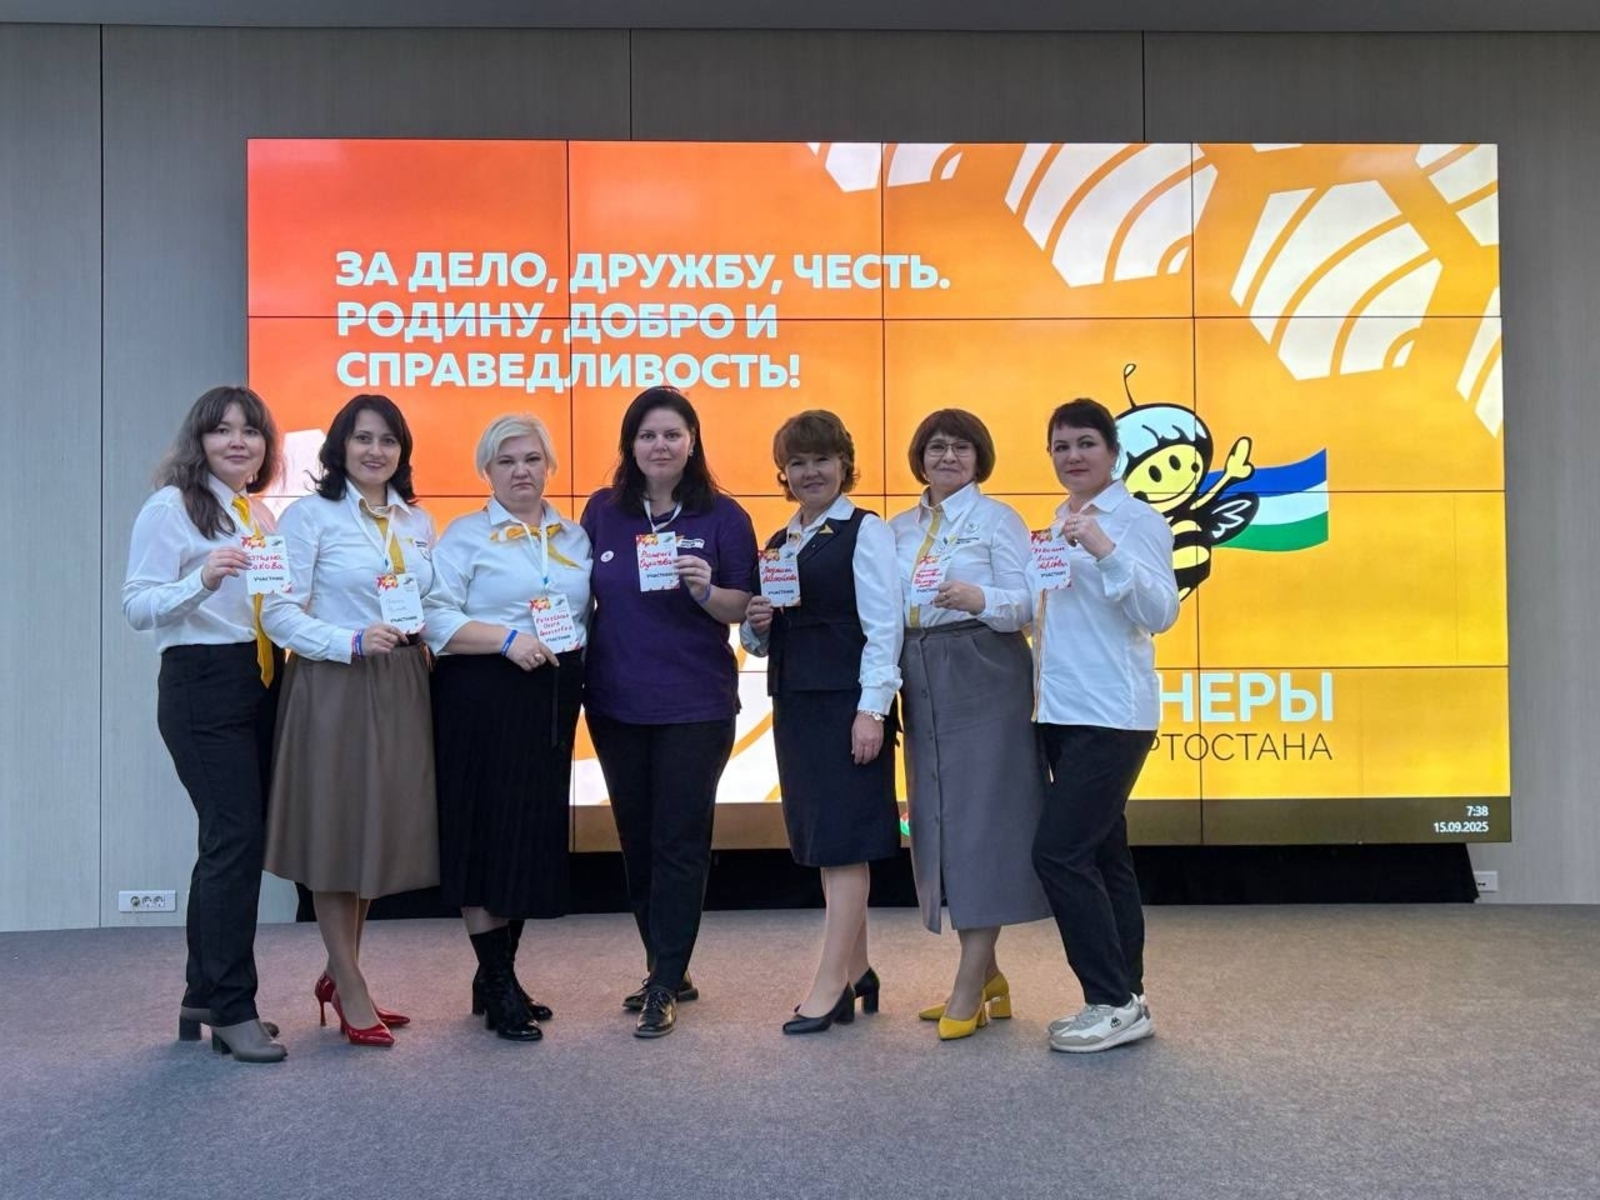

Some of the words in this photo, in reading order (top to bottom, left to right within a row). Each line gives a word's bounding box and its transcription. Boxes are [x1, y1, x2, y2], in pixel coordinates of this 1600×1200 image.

[335, 251, 399, 287] ЗА
[408, 252, 558, 293] ДЕЛО,
[569, 253, 783, 295] ДРУЖБУ,
[793, 254, 950, 289] ЧЕСТЬ.
[337, 301, 553, 343] РОДИНУ,
[563, 303, 735, 344] ДОБРО
[746, 304, 777, 339] И
[336, 352, 801, 394] СПРАВЕДЛИВОСТЬ!
[1158, 672, 1333, 722] НЕРЫ
[1433, 821, 1490, 833] 15.09.2025
[1465, 805, 1490, 817] 7:38
